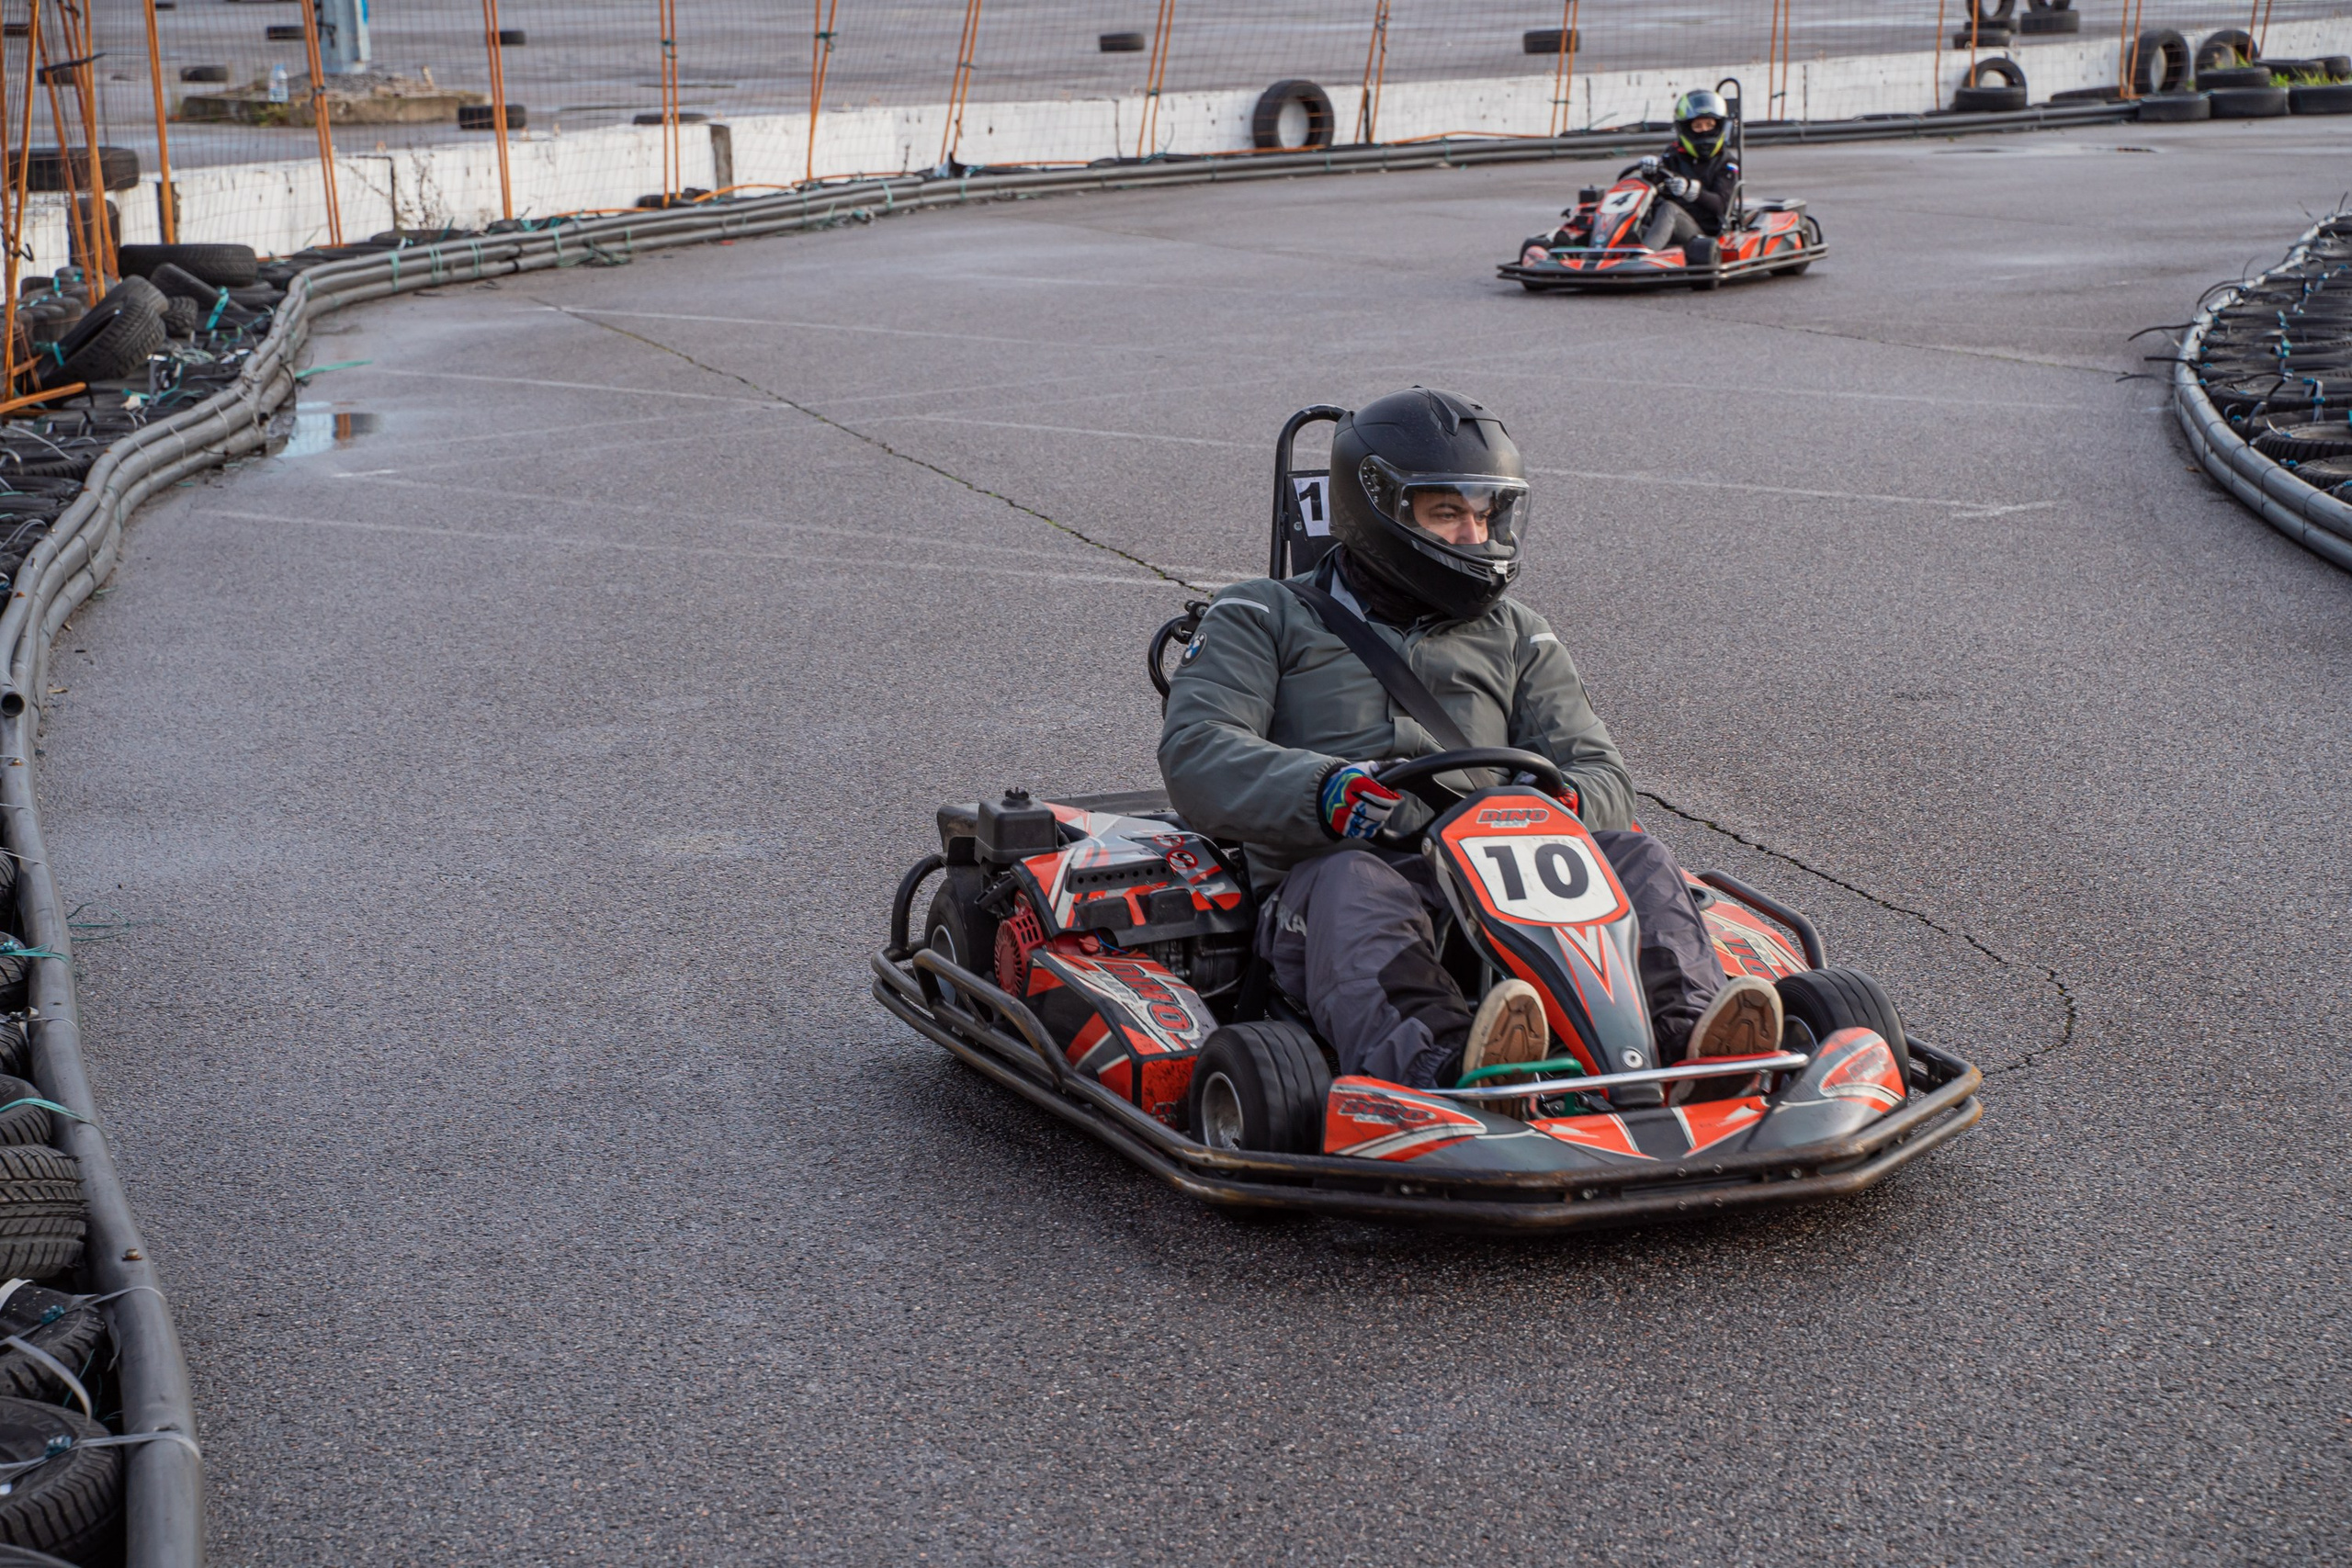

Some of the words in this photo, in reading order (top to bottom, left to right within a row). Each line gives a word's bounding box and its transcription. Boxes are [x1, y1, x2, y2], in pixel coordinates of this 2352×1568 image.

[1611, 192, 1634, 206] 4
[1298, 481, 1324, 521] 1
[1477, 809, 1548, 822] DINO
[1483, 842, 1589, 900] 10
[1094, 961, 1194, 1032] DINO
